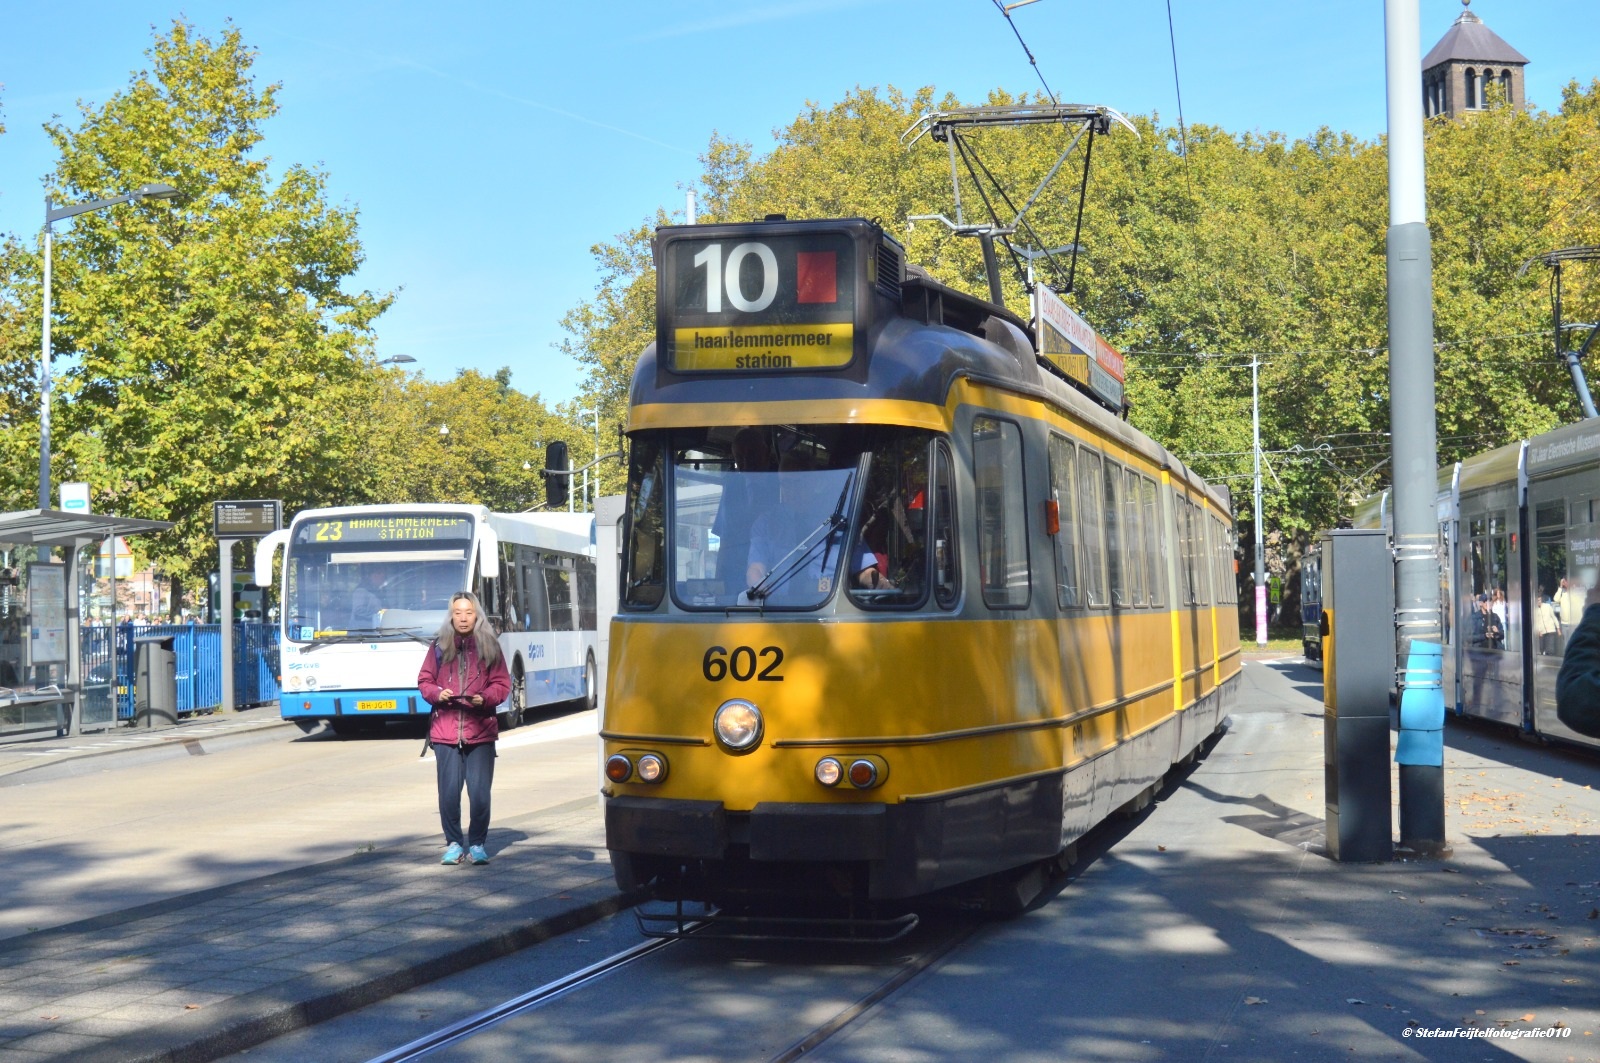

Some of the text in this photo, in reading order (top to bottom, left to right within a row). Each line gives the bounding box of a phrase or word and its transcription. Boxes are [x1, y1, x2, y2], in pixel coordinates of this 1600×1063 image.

[694, 242, 779, 313] 10
[694, 331, 833, 349] haarlemmermeer
[735, 351, 792, 369] station
[316, 521, 343, 541] 23
[380, 528, 434, 540] STATION
[820, 581, 827, 591] 3
[302, 629, 312, 638] 23
[702, 645, 784, 682] 602
[361, 701, 393, 710] BH-JG-13
